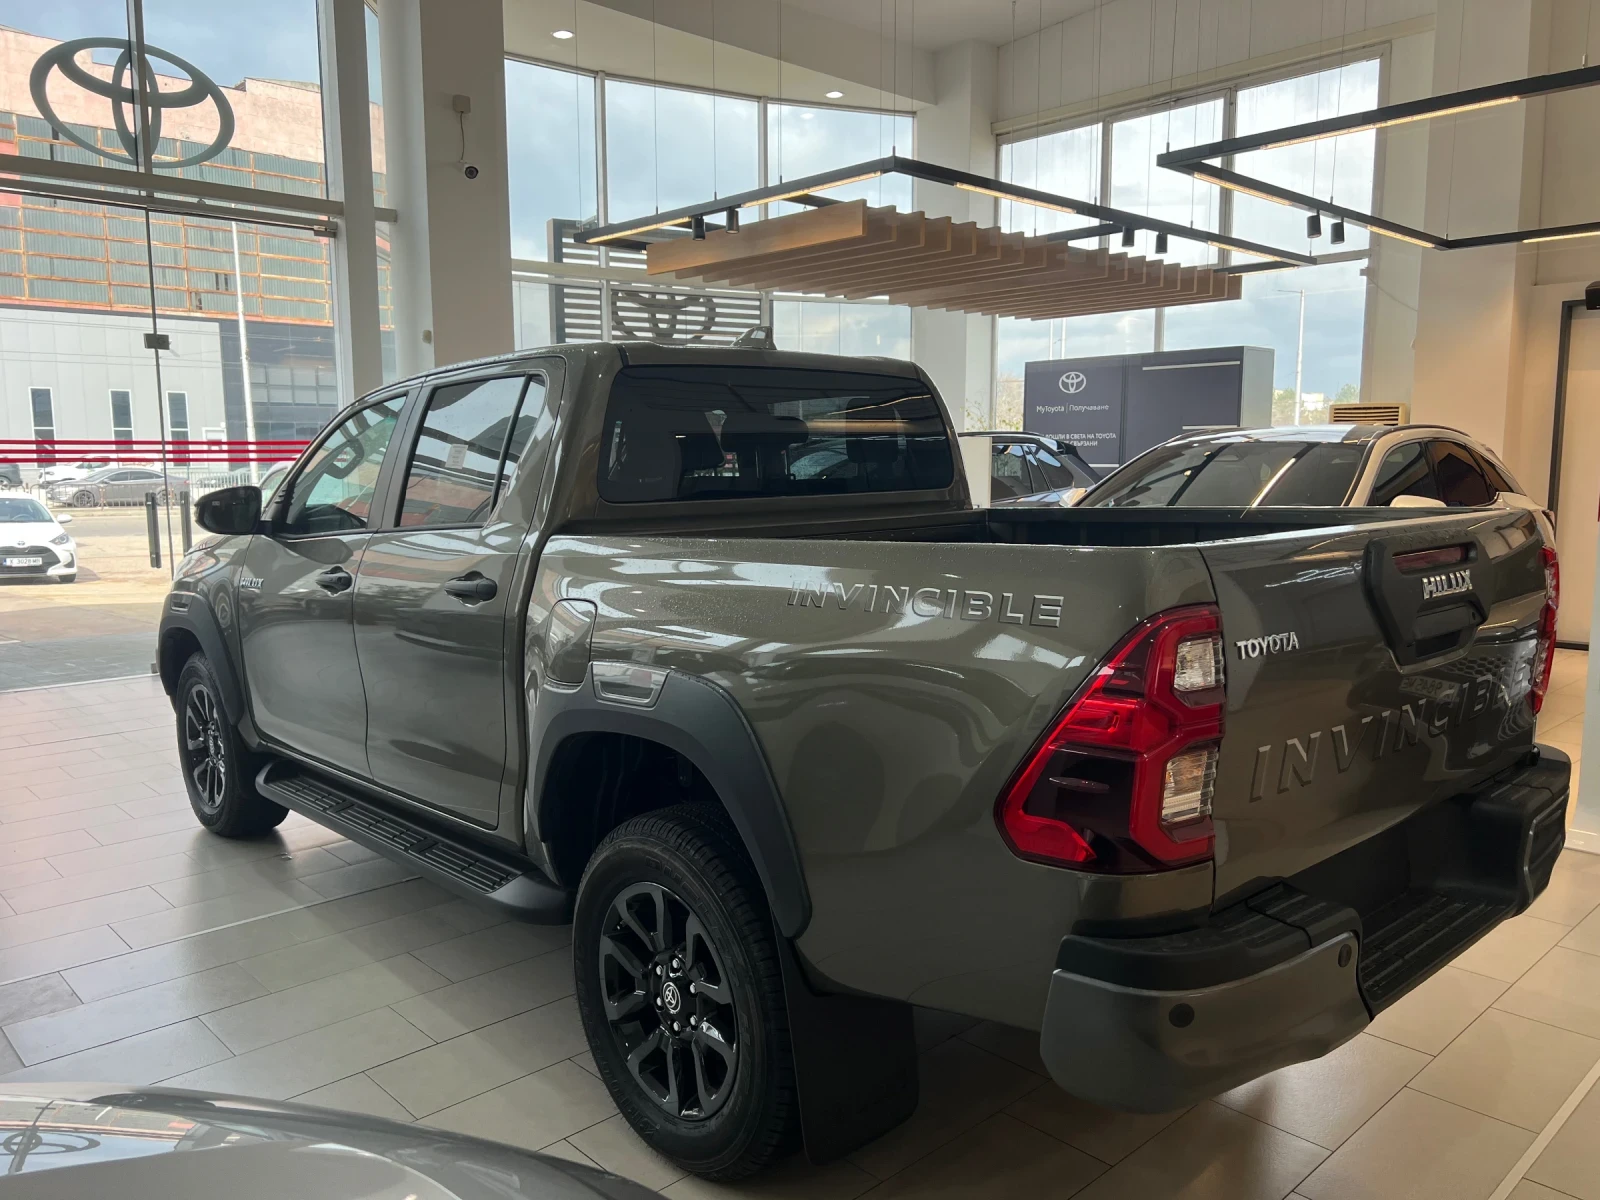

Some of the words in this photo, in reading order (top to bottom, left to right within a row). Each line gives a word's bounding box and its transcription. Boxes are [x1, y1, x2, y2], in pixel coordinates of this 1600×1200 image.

[1036, 405, 1065, 414] MyToyota
[1421, 569, 1473, 600] HILUX
[786, 579, 1065, 628] INVINCIBLE
[1235, 631, 1300, 660] TOYOTA
